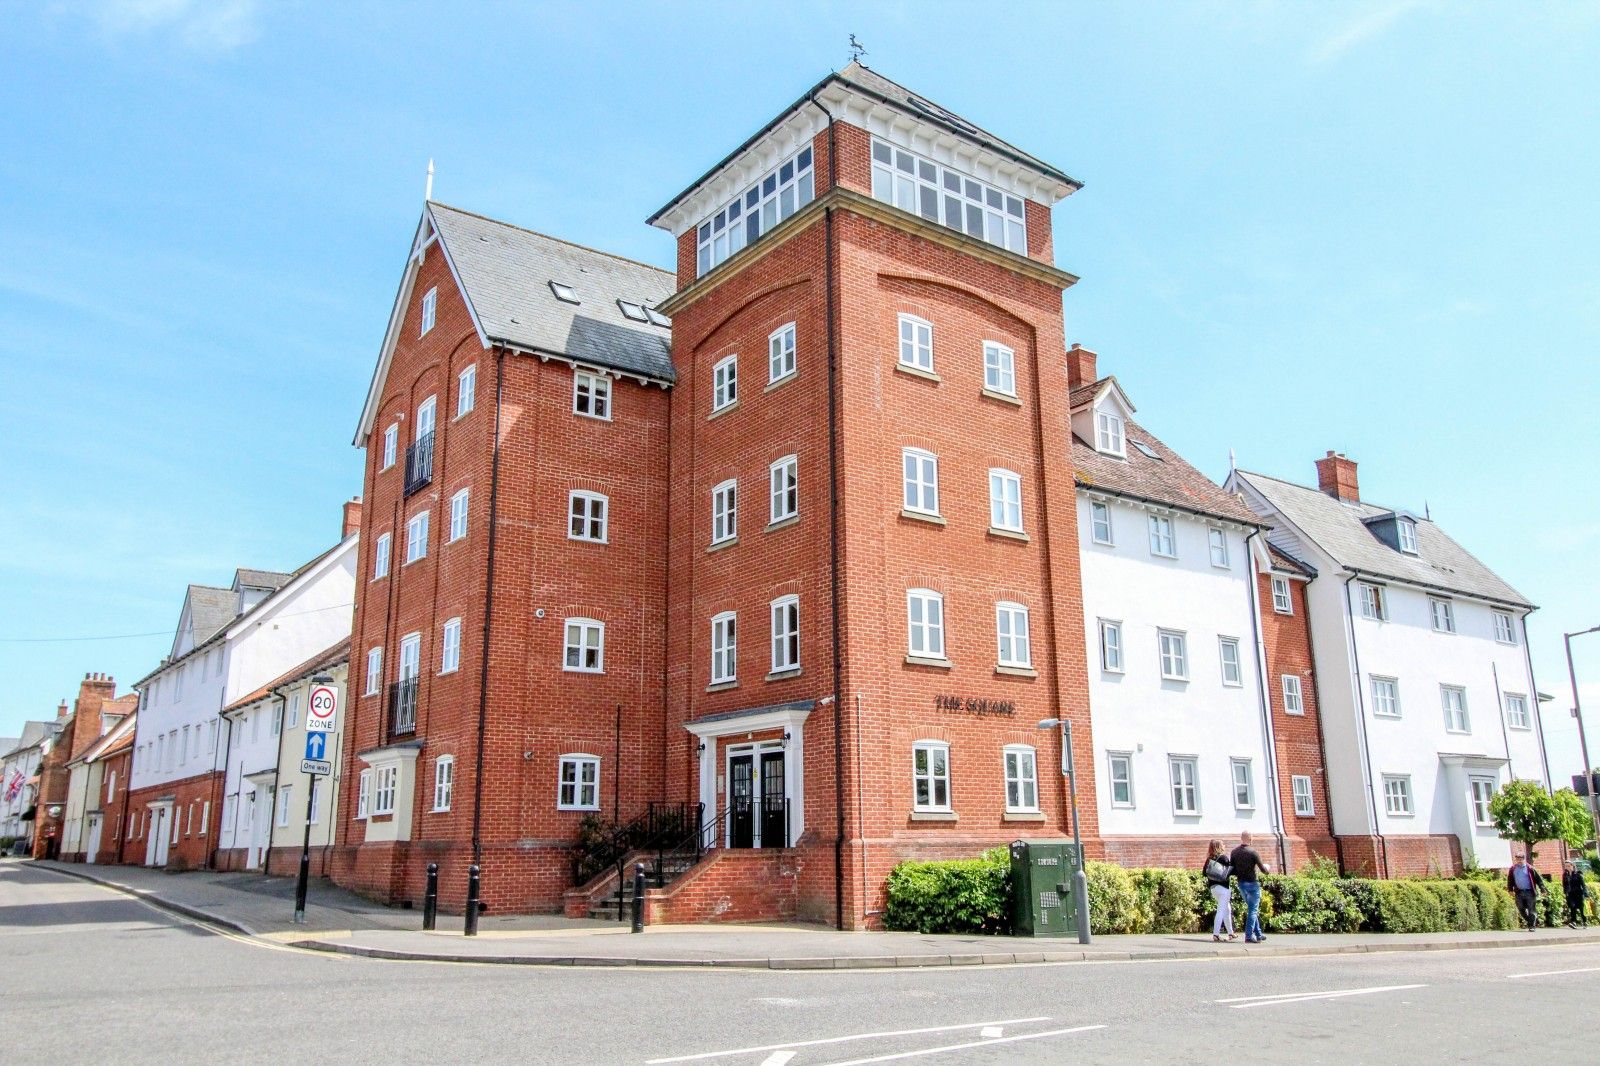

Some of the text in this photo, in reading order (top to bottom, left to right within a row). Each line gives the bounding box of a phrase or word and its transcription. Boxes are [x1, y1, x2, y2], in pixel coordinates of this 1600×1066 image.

[314, 696, 332, 709] 20
[934, 694, 1016, 717] THE SQUARE
[309, 719, 333, 729] ZONE
[303, 762, 328, 772] One way
